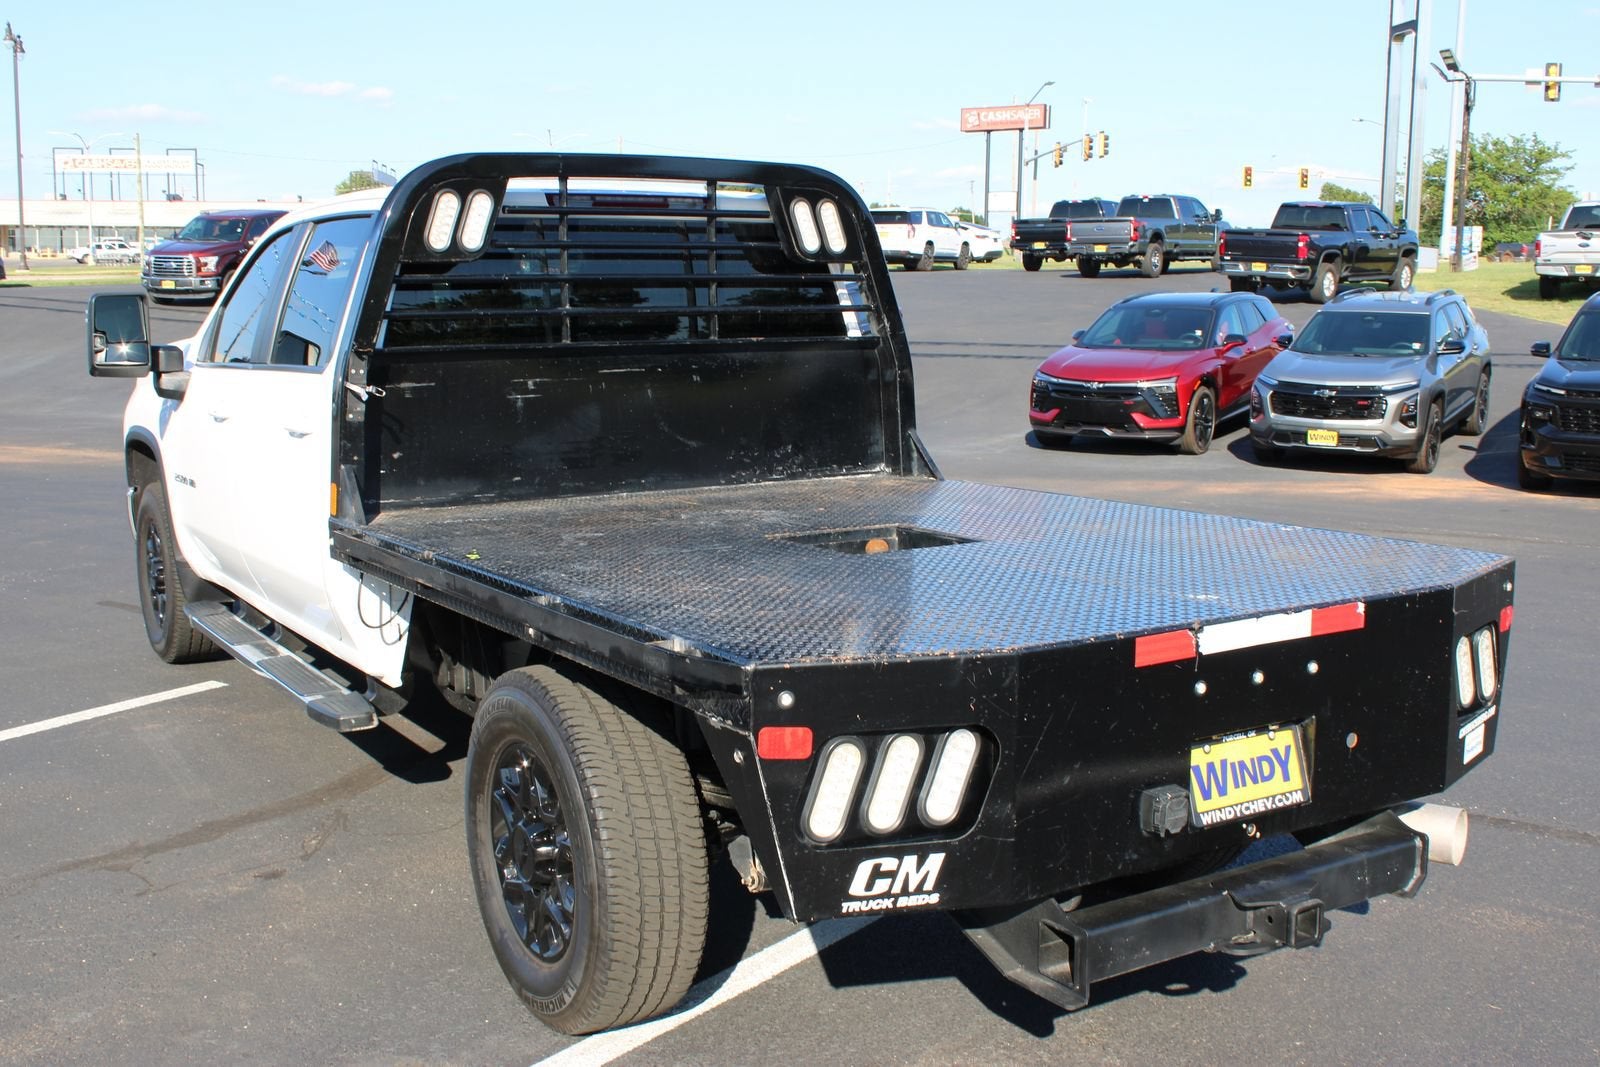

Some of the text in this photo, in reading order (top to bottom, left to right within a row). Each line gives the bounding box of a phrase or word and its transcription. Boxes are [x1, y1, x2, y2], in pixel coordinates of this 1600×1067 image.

[1309, 433, 1336, 441] WINDY
[1191, 744, 1291, 801] WINDY
[1200, 790, 1303, 825] WINDYCHEV.COM
[848, 852, 946, 896] CM
[841, 893, 940, 913] TRUCK BEDS
